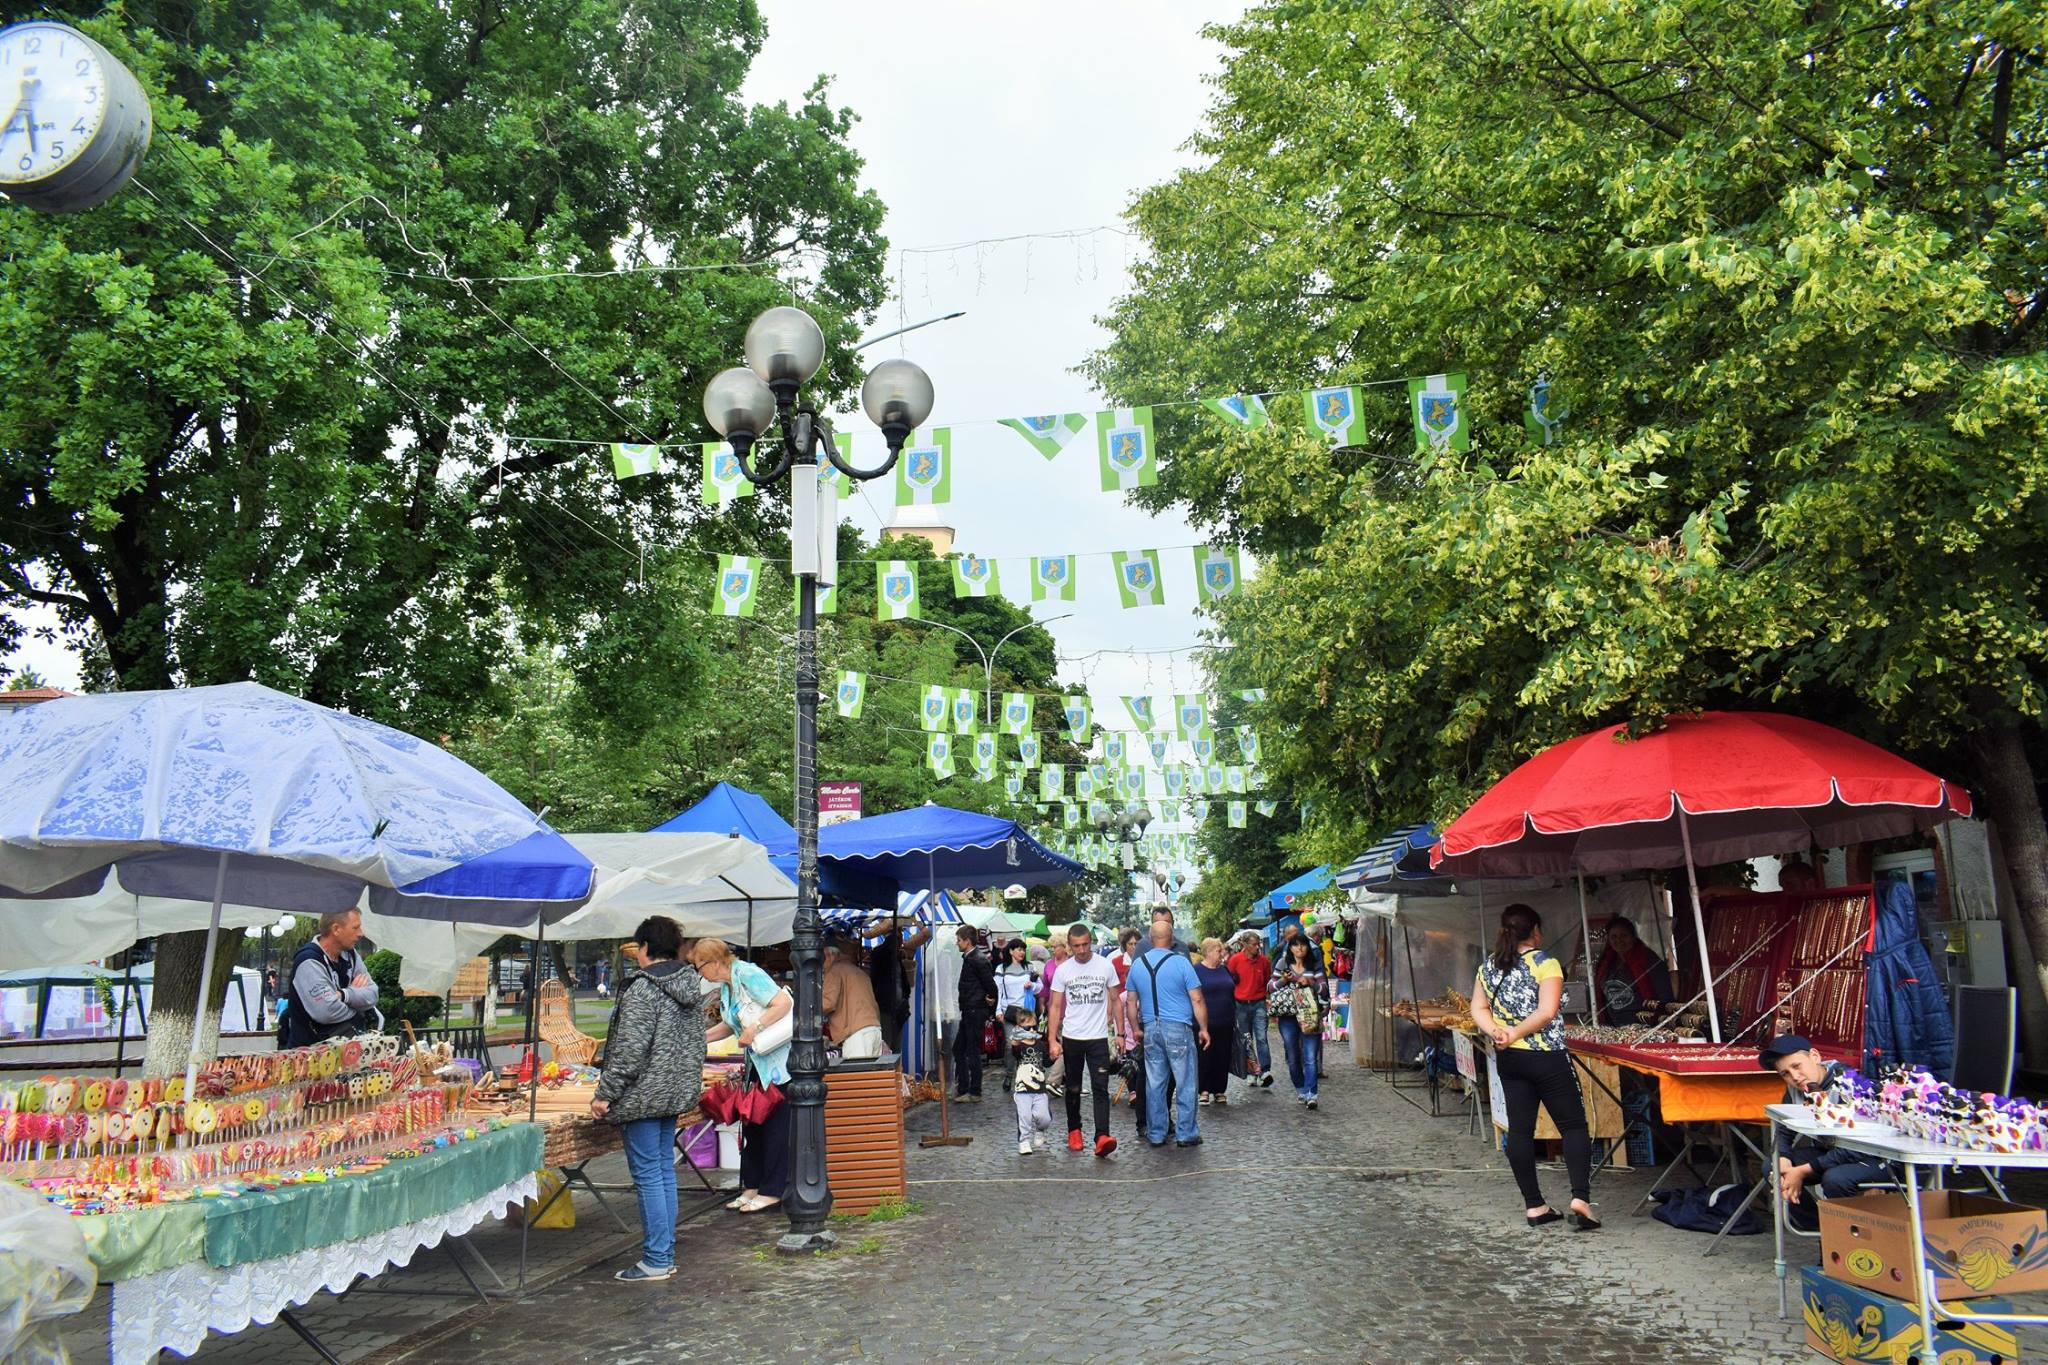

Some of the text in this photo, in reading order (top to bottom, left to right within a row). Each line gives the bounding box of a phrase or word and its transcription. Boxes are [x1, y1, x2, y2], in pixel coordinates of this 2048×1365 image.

[24, 37, 42, 54] 12
[76, 59, 90, 77] 2
[84, 86, 97, 104] 3
[71, 117, 85, 135] 4
[51, 141, 64, 159] 5
[19, 153, 32, 171] 6
